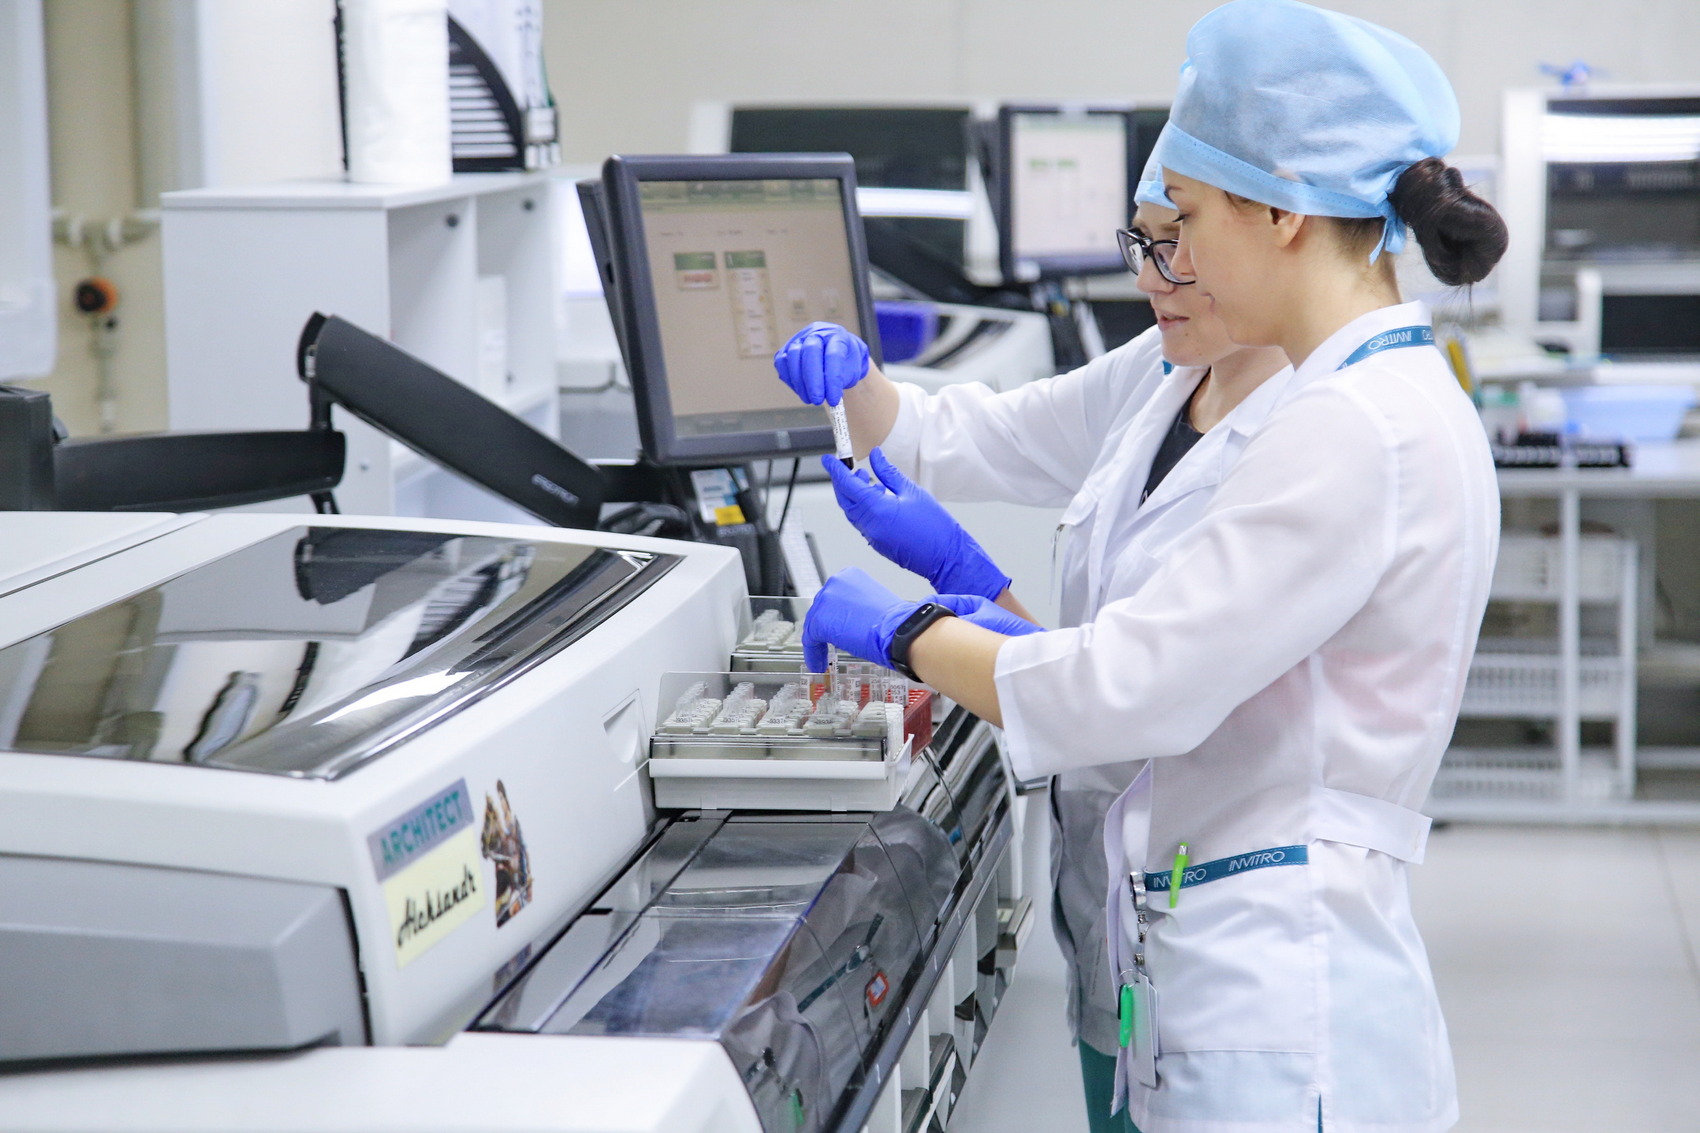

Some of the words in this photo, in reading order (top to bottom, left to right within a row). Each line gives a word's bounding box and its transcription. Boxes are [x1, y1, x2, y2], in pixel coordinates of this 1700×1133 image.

[1368, 331, 1411, 350] INVITRO
[381, 791, 463, 865] ARCHITECT
[1154, 869, 1206, 888] INVRO
[1229, 851, 1285, 872] INVITRO
